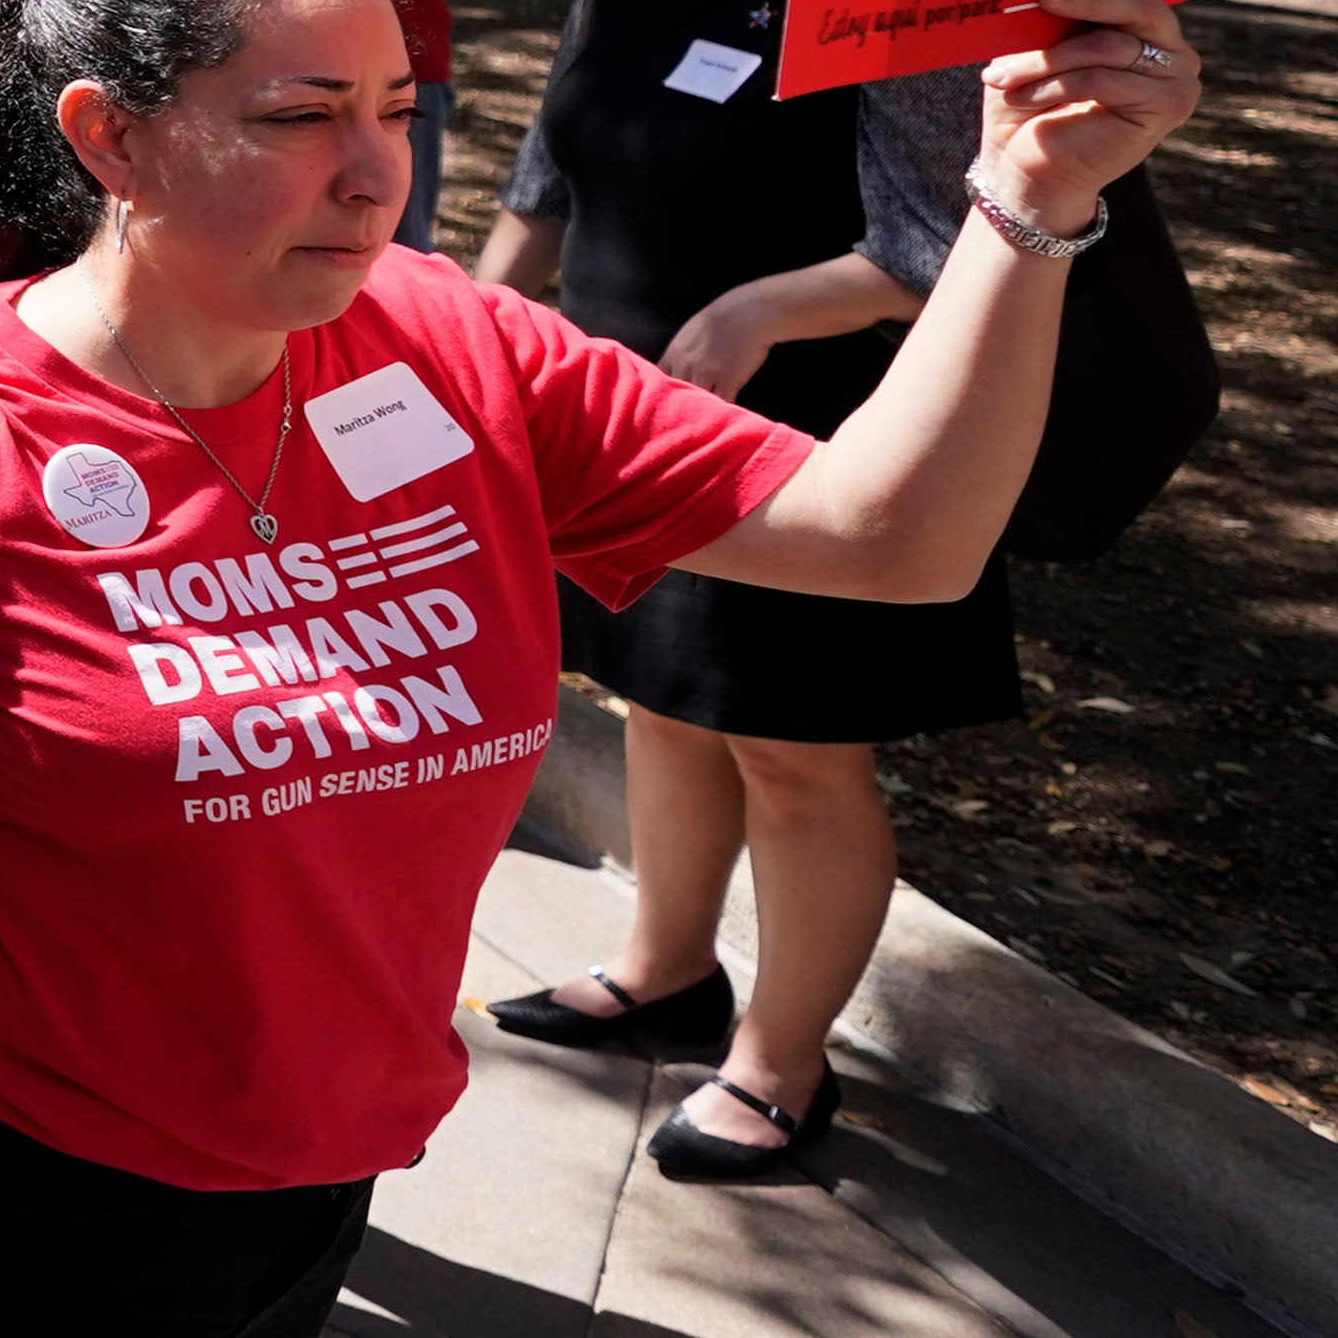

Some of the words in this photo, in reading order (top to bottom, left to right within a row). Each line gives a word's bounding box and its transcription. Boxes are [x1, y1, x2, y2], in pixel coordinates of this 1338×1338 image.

[333, 412, 376, 437] Maritza
[373, 400, 407, 419] Wong
[85, 471, 119, 487] DEMAND
[90, 480, 120, 494] ACTION
[65, 510, 112, 530] MARITZA
[97, 542, 339, 635] MOMS
[127, 588, 478, 707] DEMAND
[174, 665, 483, 783] ACTION
[183, 789, 251, 824] FOR
[261, 776, 314, 818] GUN
[318, 764, 410, 800] SENSE
[416, 754, 445, 784] IN
[451, 717, 553, 778] AMERICA
